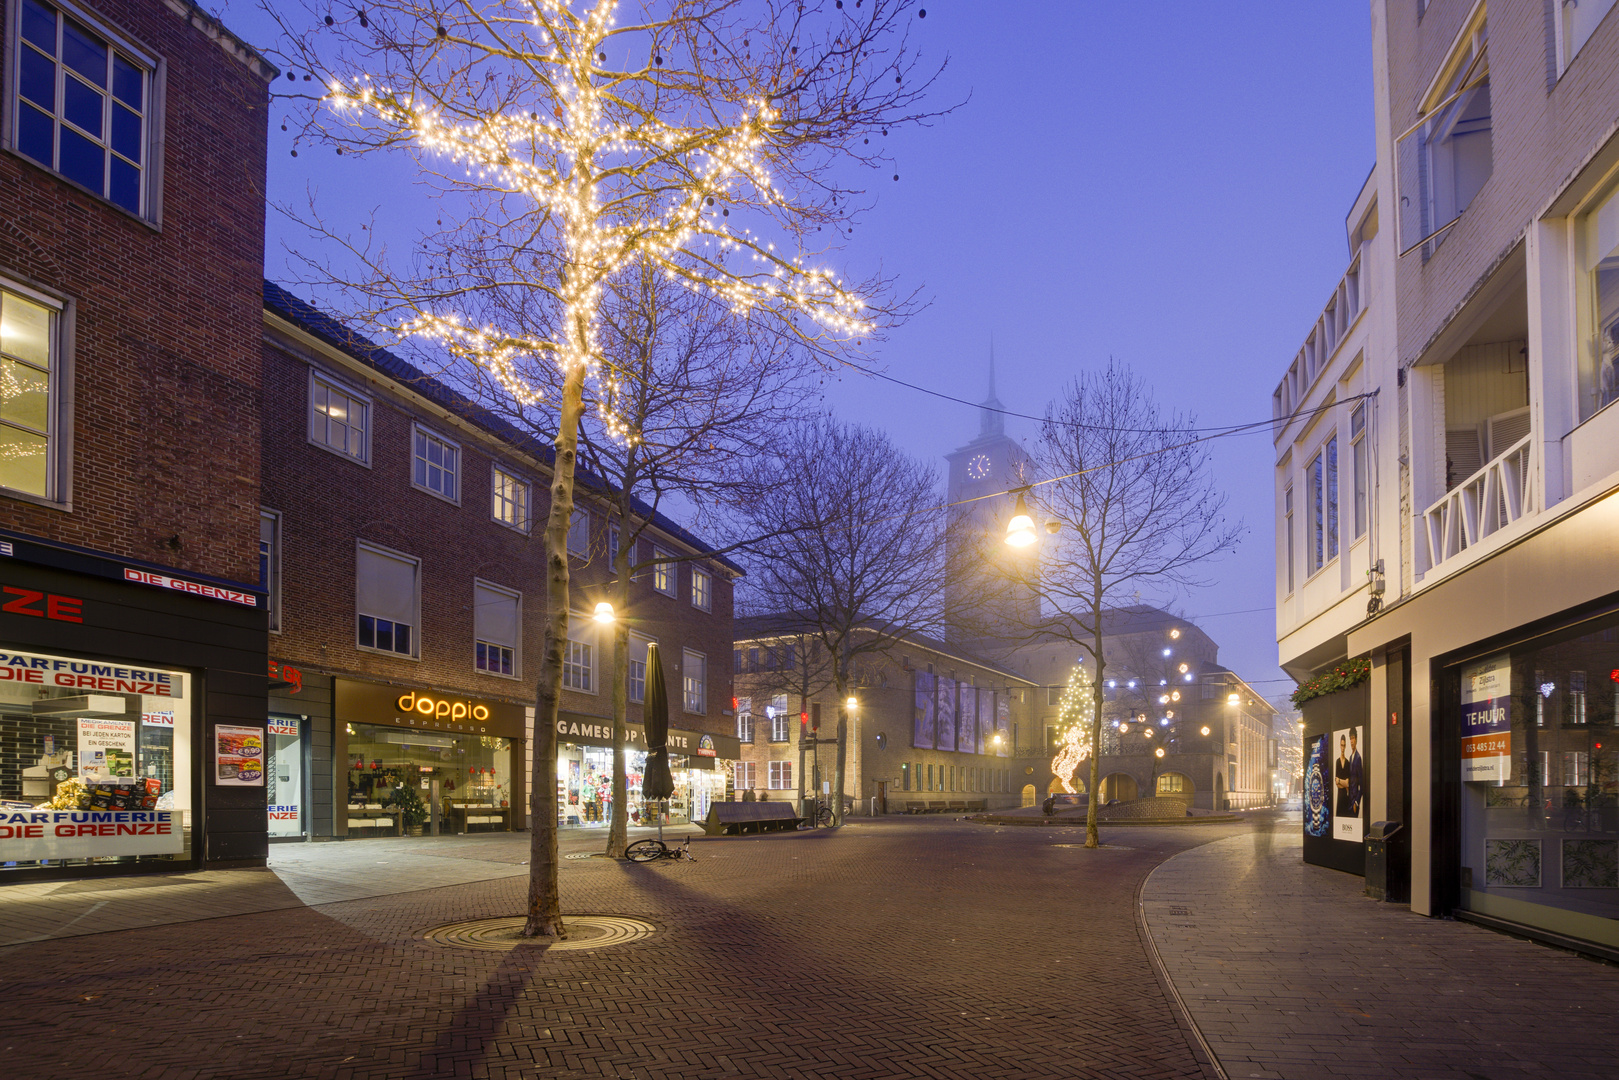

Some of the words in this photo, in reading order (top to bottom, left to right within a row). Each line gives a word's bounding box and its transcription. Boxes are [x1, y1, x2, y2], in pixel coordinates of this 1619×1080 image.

[125, 569, 163, 586] DIE
[170, 579, 256, 606] GRENZE
[2, 586, 83, 624] ZE
[0, 667, 44, 684] DIE
[54, 673, 171, 697] GRENZE
[398, 691, 489, 722] doppio
[395, 717, 486, 733] ESPRESSO
[1466, 712, 1477, 727] TE
[1478, 707, 1506, 725] HUUR
[97, 724, 132, 732] GRENZE
[557, 720, 638, 743] GAMESP
[642, 731, 688, 749] TNTE
[1466, 744, 1476, 753] 053
[1477, 742, 1488, 752] 485
[1488, 741, 1496, 751] 22
[1497, 740, 1506, 750] 44
[0, 825, 44, 839] DIE
[54, 823, 172, 838] GRENZE
[1342, 823, 1353, 832] BOSS
